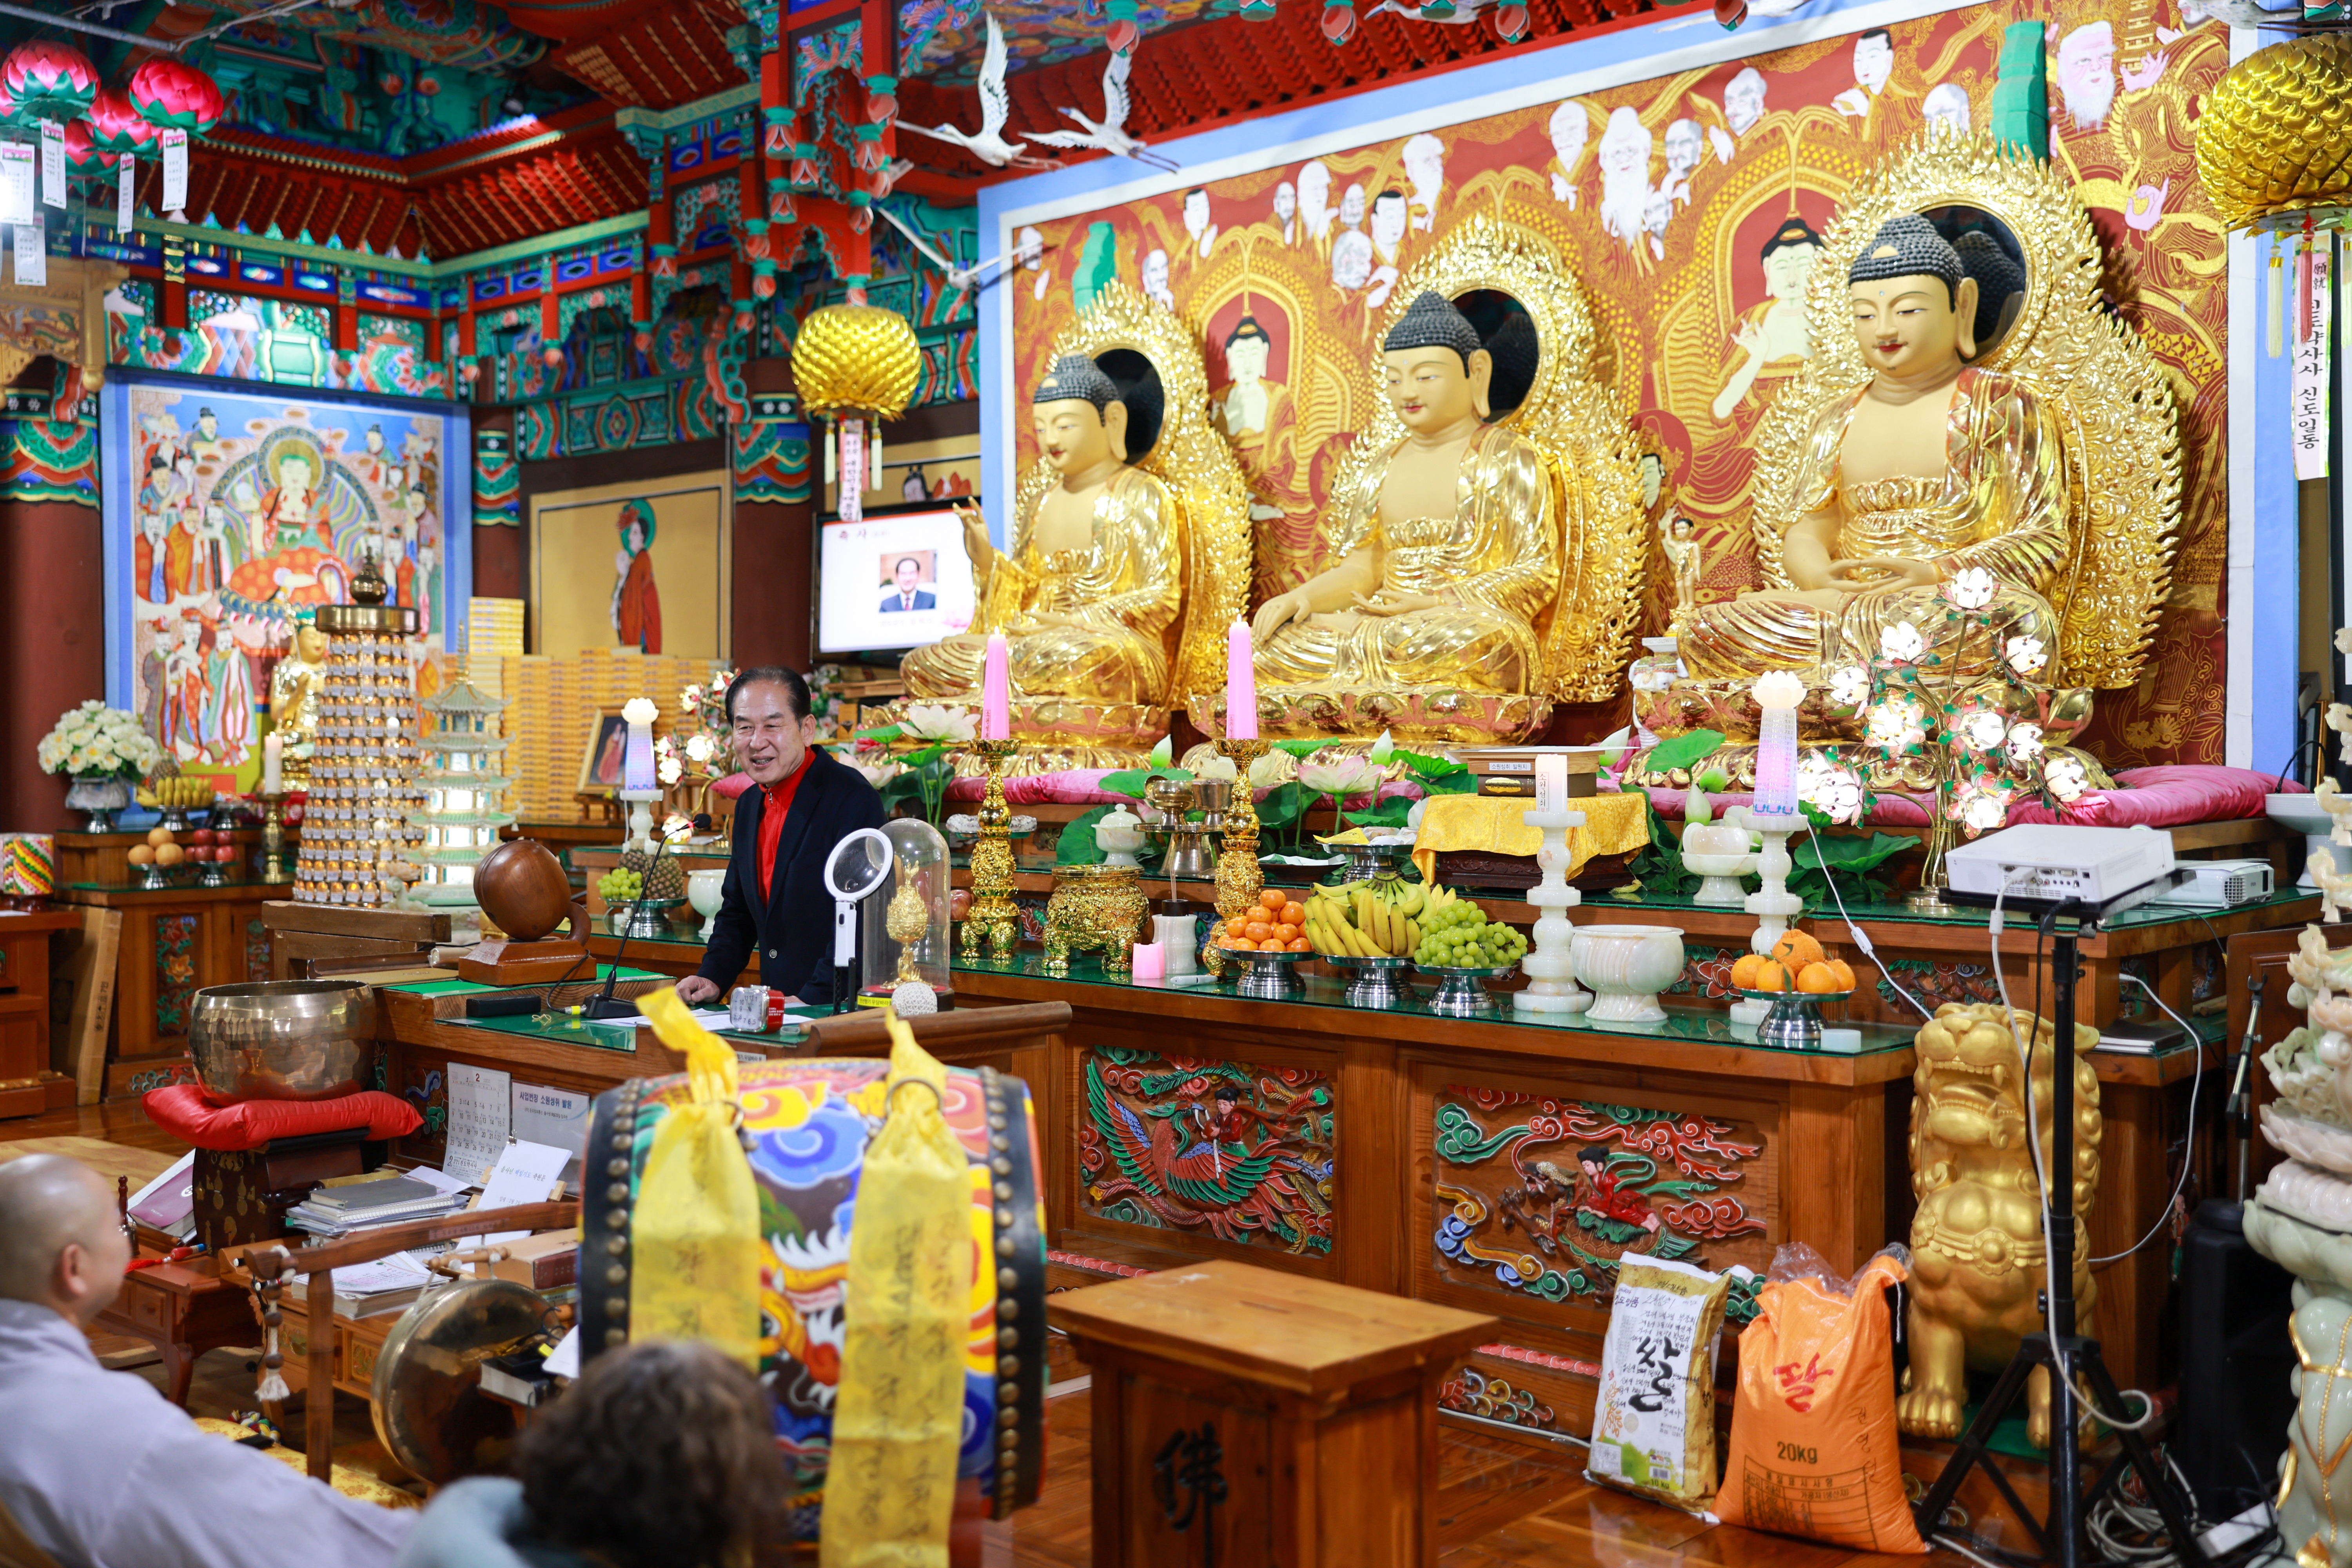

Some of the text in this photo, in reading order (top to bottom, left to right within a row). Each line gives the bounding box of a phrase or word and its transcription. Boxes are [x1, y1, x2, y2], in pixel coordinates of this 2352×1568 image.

[2297, 387, 2320, 449] 신도일동
[476, 1073, 480, 1082] 2
[562, 1099, 572, 1109] 발원
[501, 1166, 514, 1175] 을사년
[533, 1173, 546, 1181] 축원문
[1628, 1336, 1681, 1412] 쌀
[1777, 1441, 1818, 1464] 20kg
